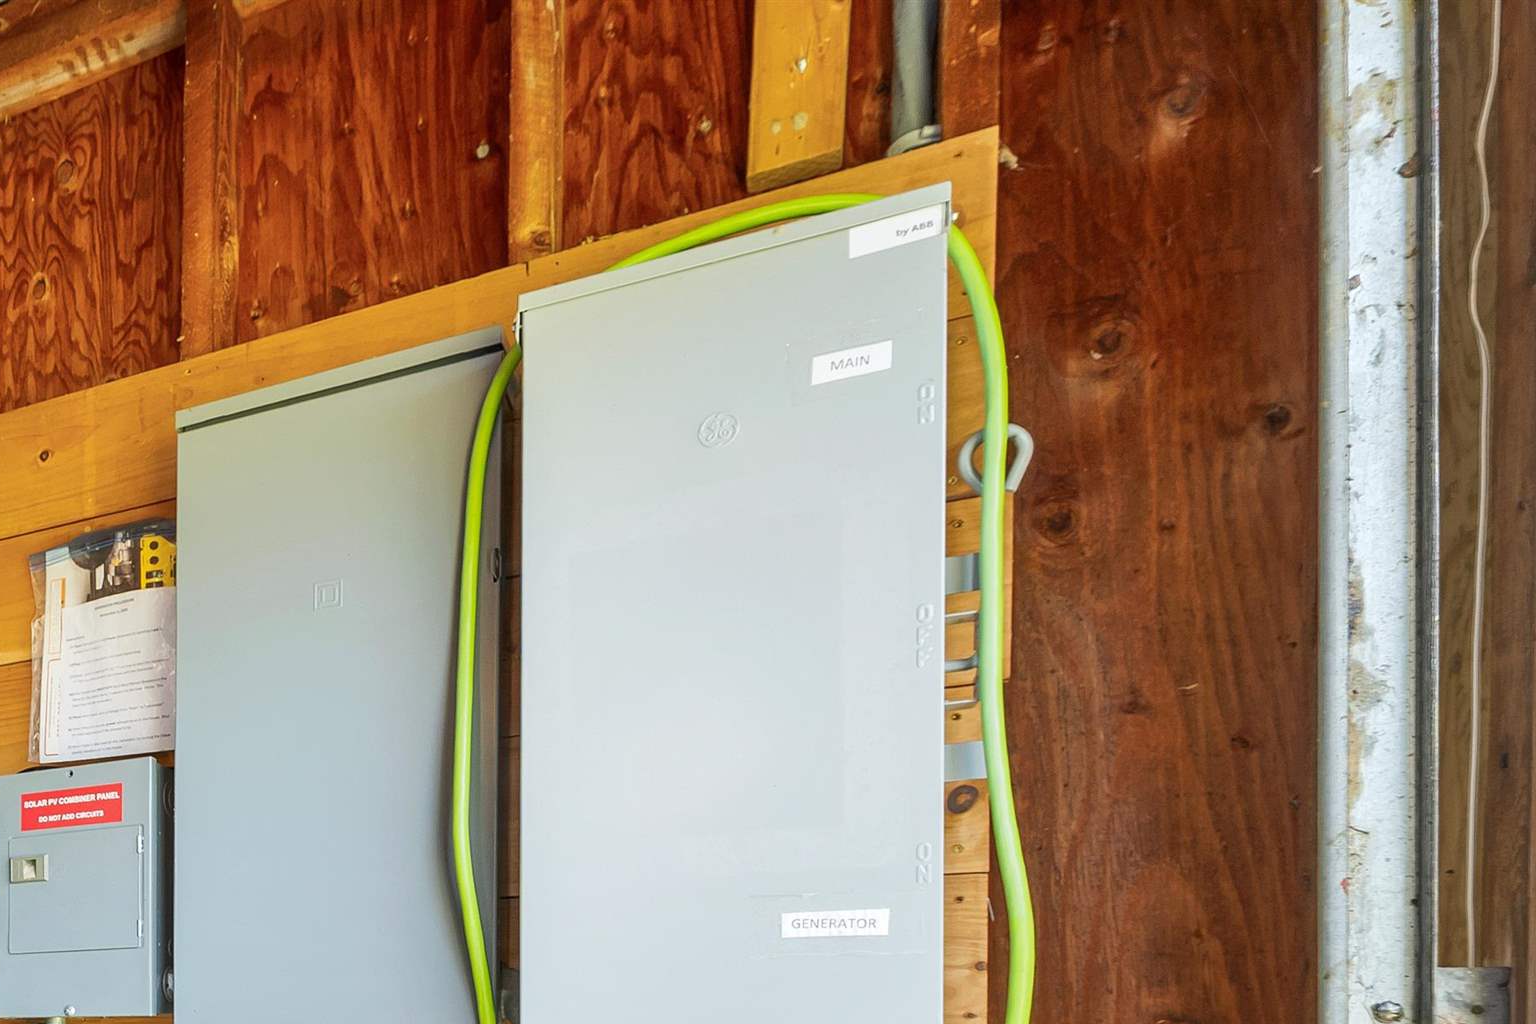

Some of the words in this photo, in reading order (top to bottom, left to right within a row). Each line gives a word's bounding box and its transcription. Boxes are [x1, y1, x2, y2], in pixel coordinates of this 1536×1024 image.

[895, 228, 909, 237] by
[829, 354, 871, 371] MAIN
[24, 799, 48, 809] SOLAR
[48, 797, 58, 807] PV
[58, 793, 97, 805] COMBINER
[96, 791, 121, 801] PANEL
[38, 815, 49, 823] DO
[49, 814, 62, 822] NOT
[61, 812, 75, 821] ADD
[75, 810, 104, 819] CIRCUITS
[790, 918, 878, 930] GENERATOR
